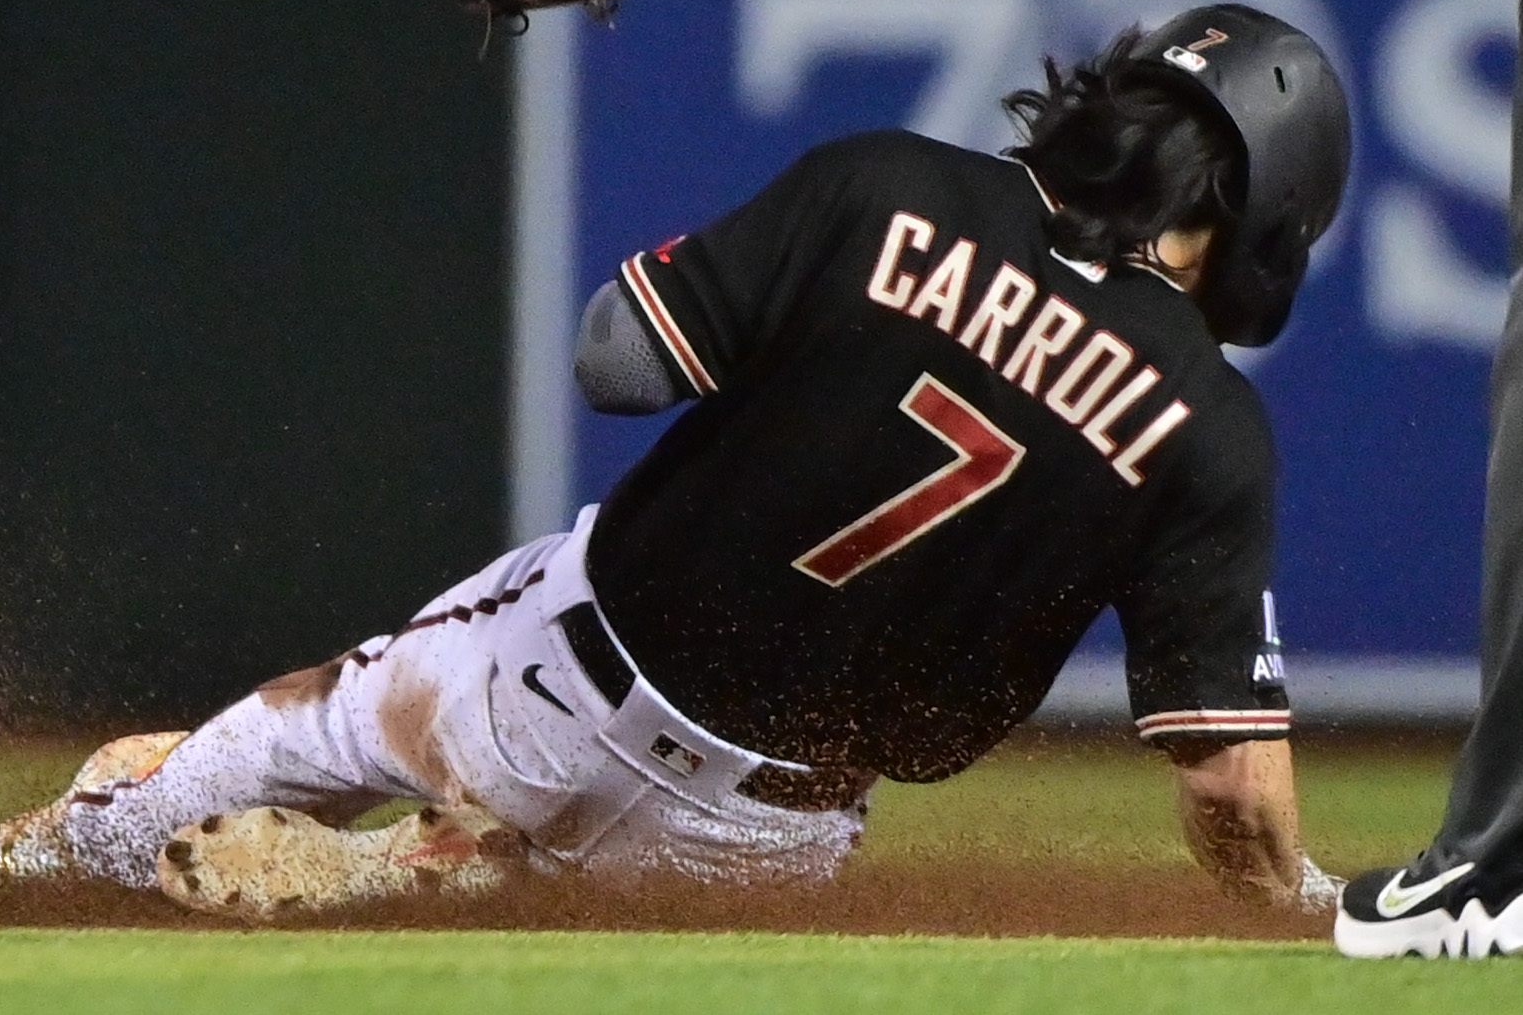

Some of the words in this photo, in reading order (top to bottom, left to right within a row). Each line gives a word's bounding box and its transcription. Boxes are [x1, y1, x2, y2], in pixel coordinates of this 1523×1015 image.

[1187, 27, 1229, 51] 7
[866, 210, 1191, 486] CARROLL
[790, 370, 1027, 588] 7
